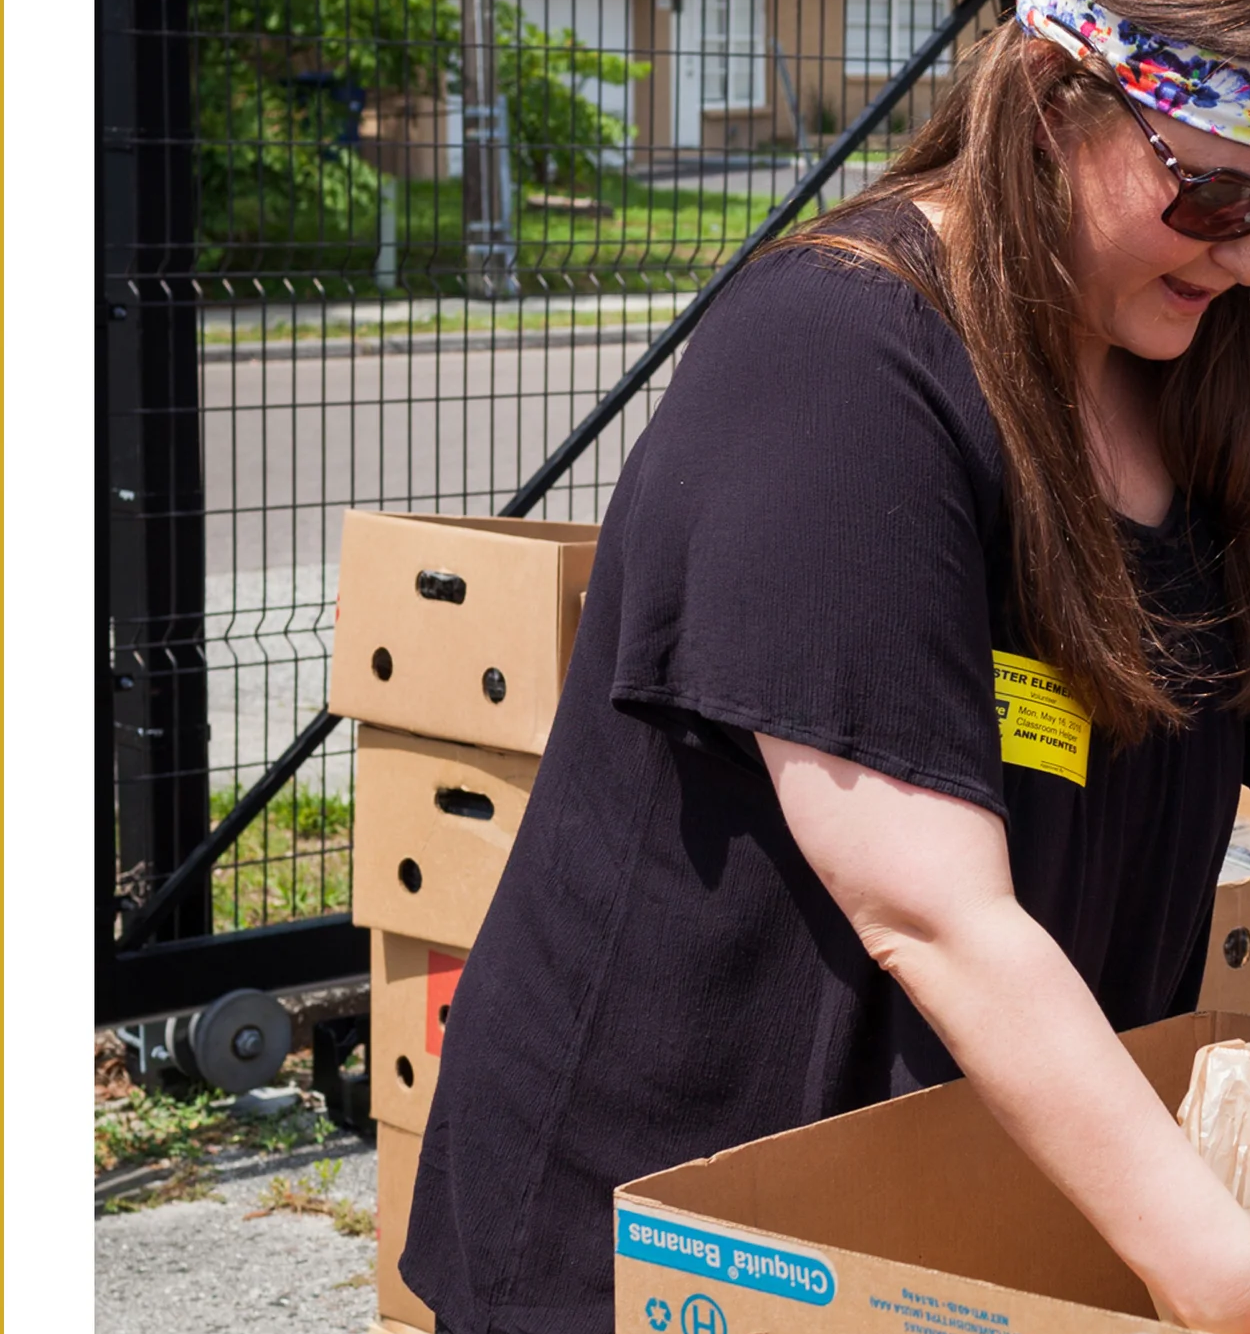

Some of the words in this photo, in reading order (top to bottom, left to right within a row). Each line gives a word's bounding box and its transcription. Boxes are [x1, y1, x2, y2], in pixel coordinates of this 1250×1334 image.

[1030, 691, 1057, 704] Volunteer
[1016, 717, 1057, 735] Classroom
[1041, 711, 1056, 725] May
[1014, 729, 1037, 742] ANN
[1040, 736, 1077, 754] FUENTES
[629, 1223, 720, 1268] Bananas
[990, 1313, 1009, 1326] NET
